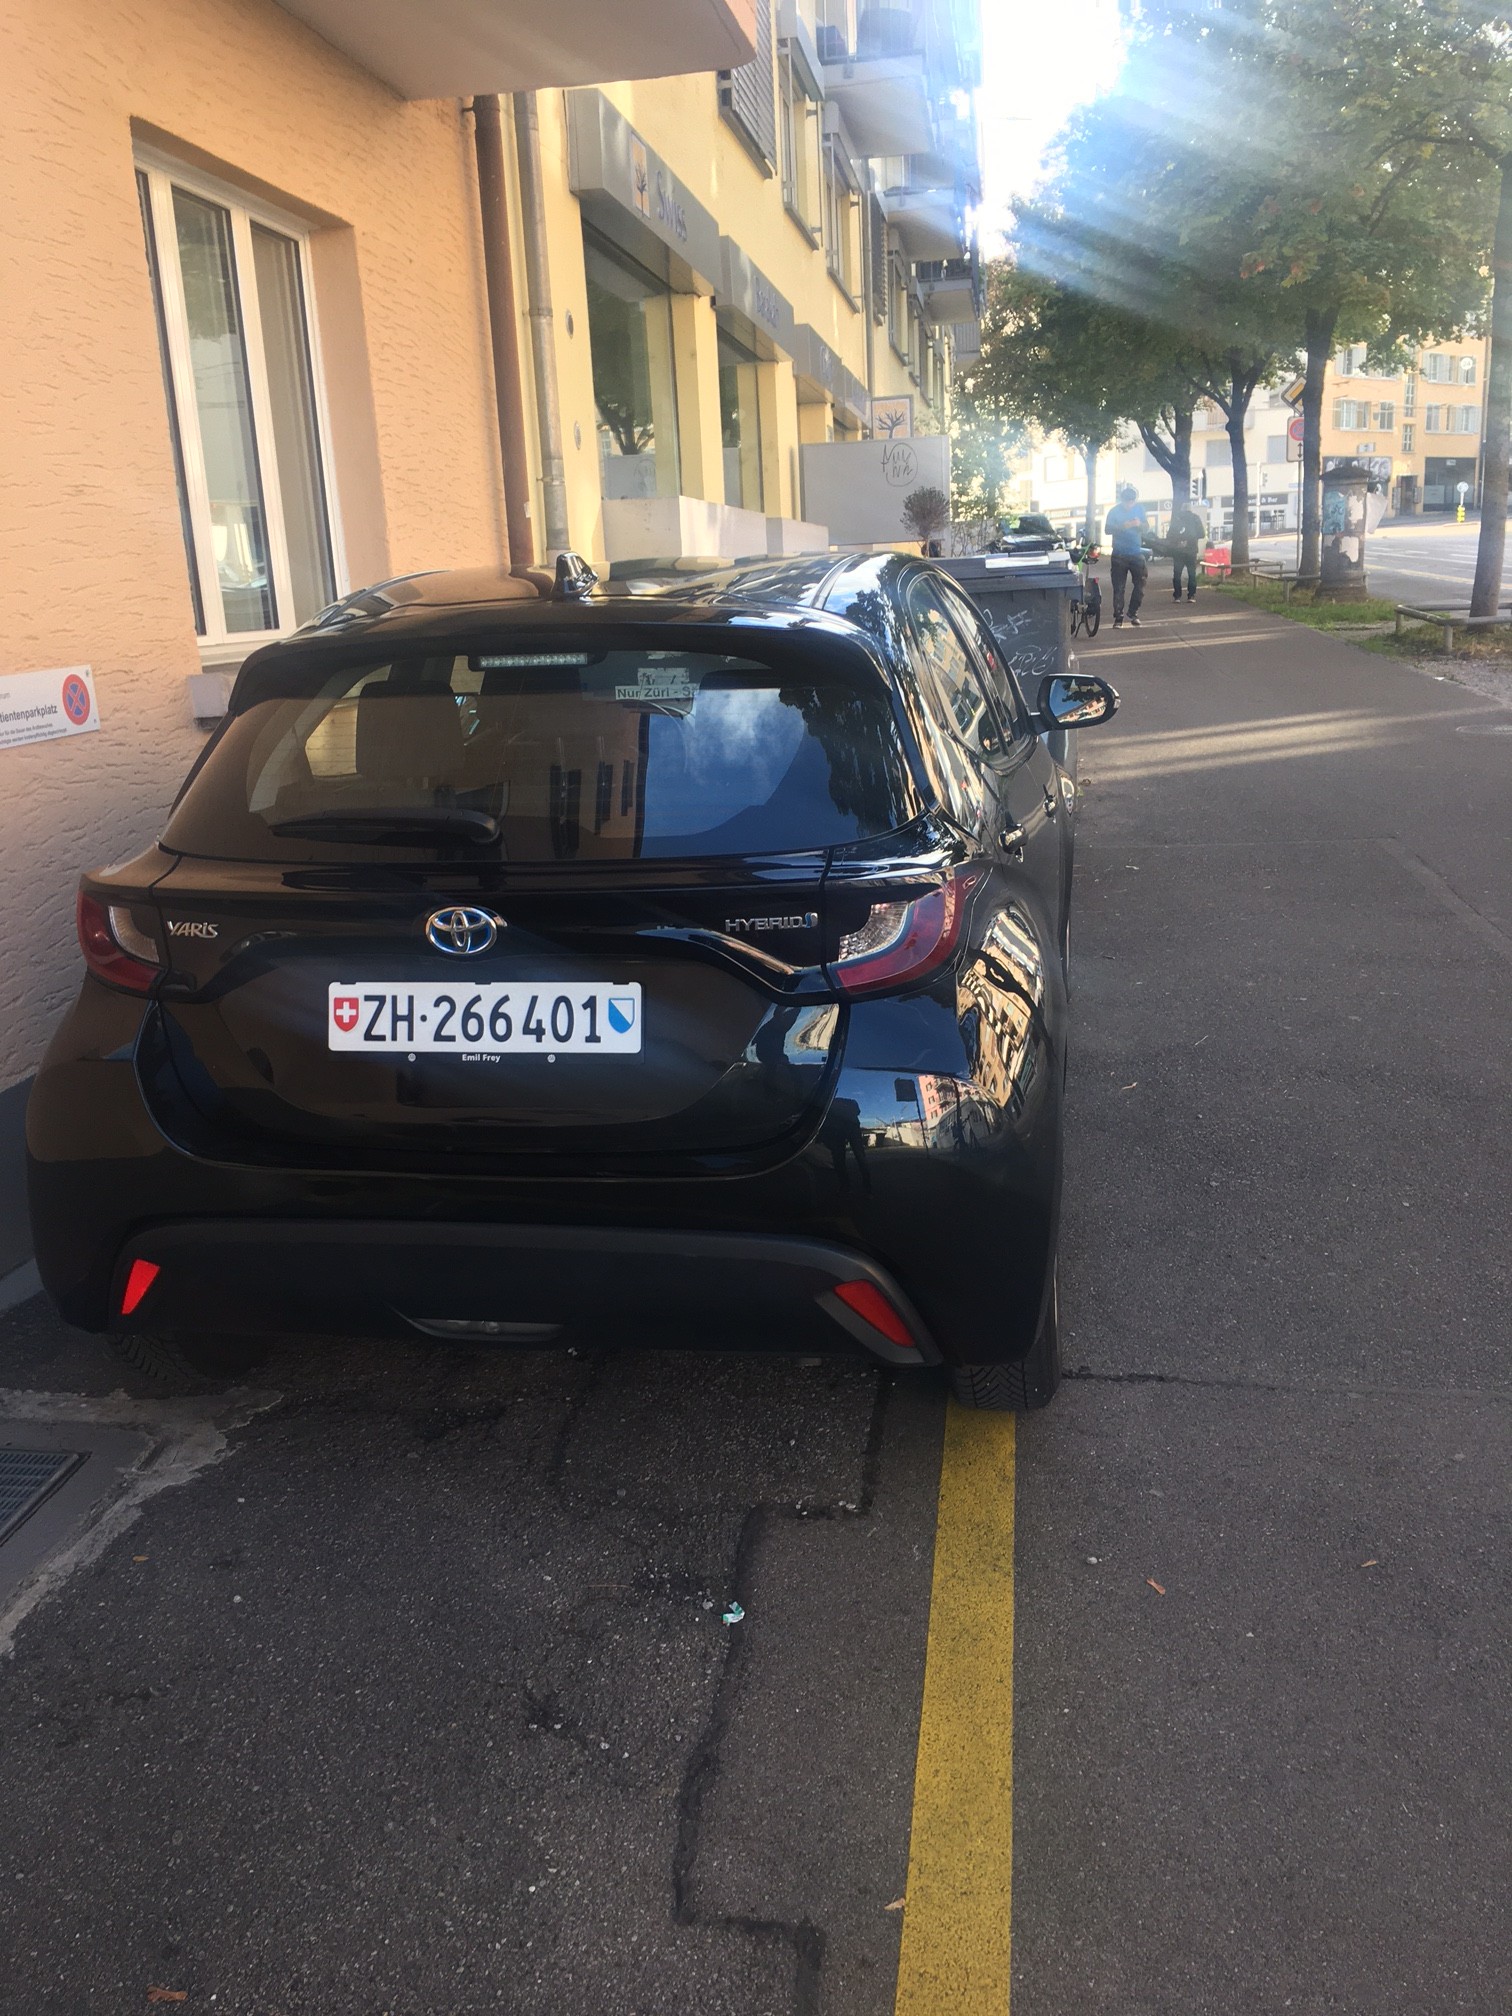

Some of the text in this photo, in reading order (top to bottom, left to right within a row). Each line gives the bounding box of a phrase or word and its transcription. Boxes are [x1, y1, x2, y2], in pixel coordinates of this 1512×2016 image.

[617, 688, 640, 698] Nur
[644, 687, 670, 698] Züri
[725, 916, 803, 932] HYBRID
[462, 1053, 501, 1063] Emil Frey
